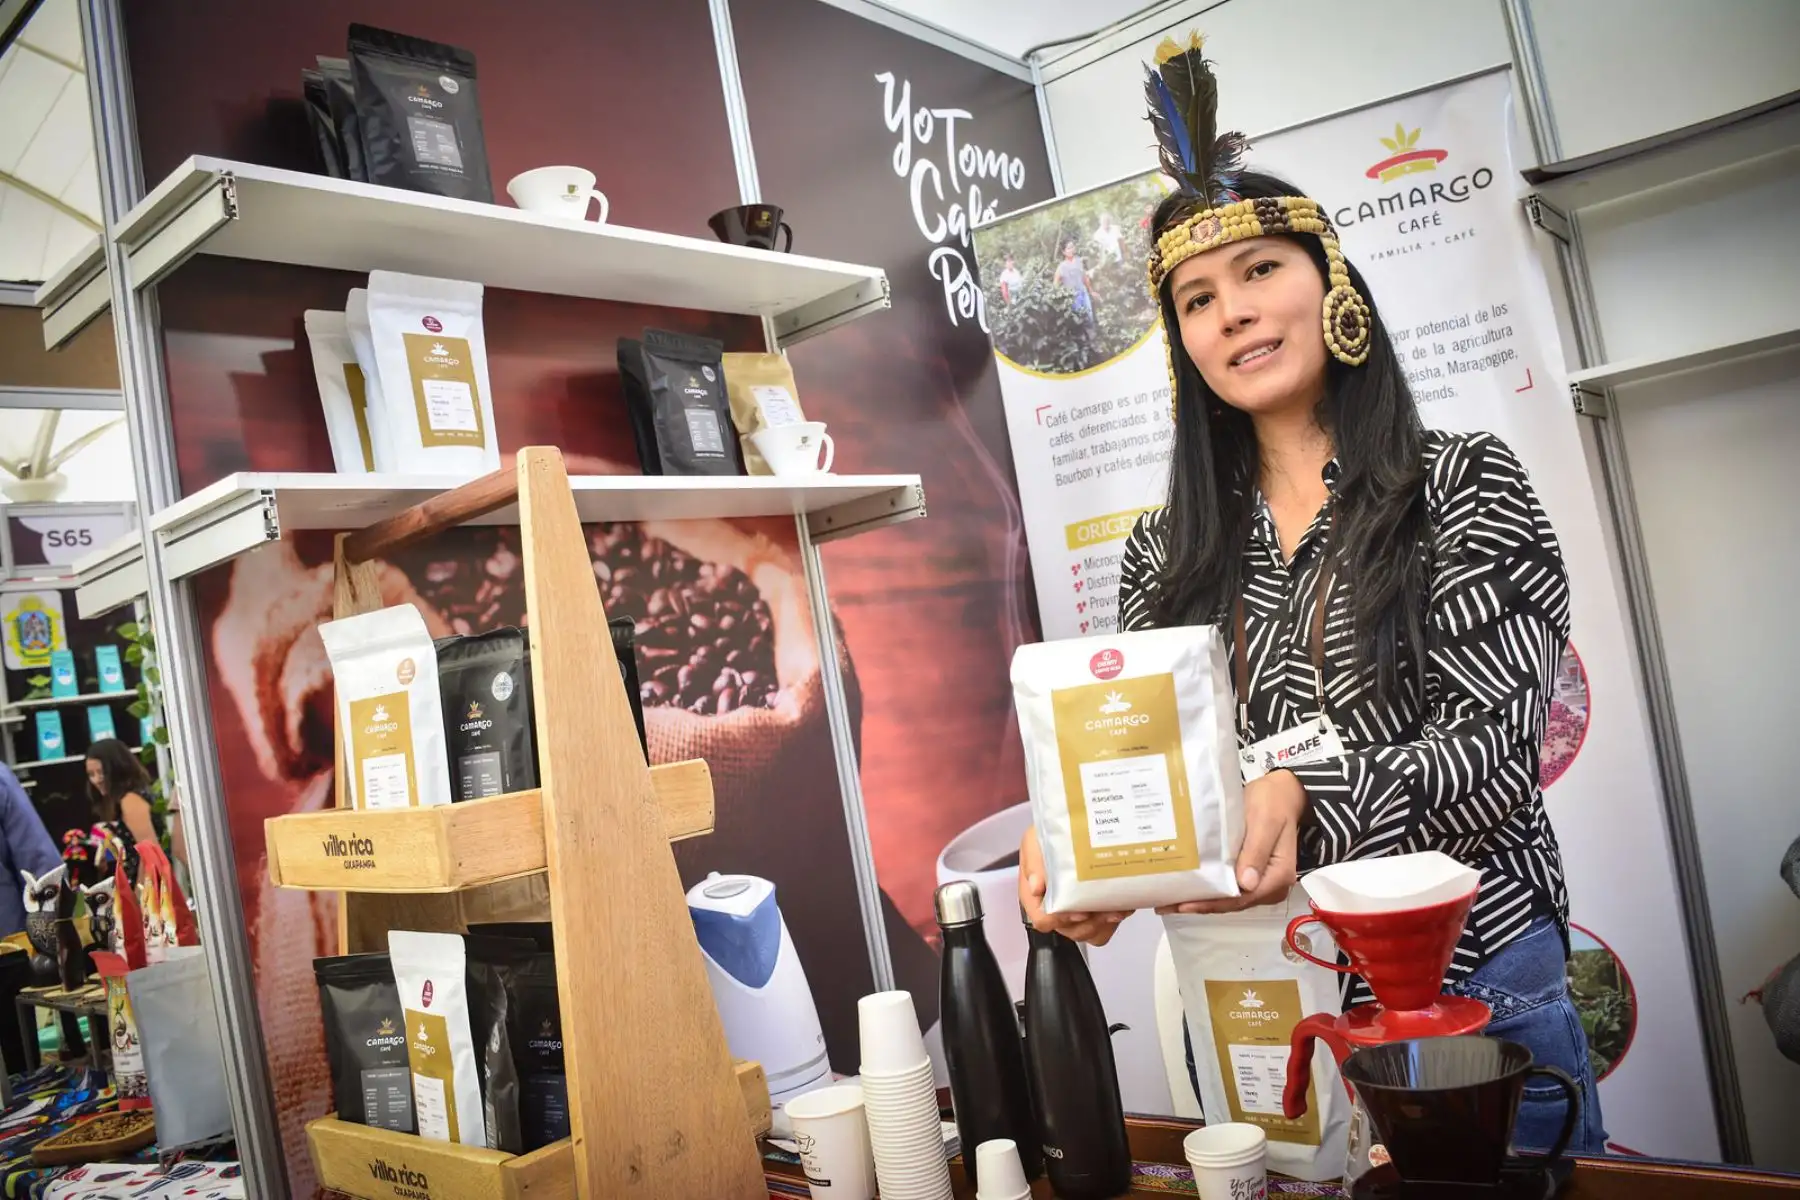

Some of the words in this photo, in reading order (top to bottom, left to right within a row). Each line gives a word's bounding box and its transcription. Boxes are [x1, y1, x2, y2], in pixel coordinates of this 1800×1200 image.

[875, 71, 934, 177] Yo
[931, 108, 1025, 194] Tomo
[1334, 167, 1493, 227] CAMARGO
[1398, 210, 1442, 234] CAFÉ
[1370, 242, 1422, 260] FAMILIA
[928, 246, 991, 333] Per
[1416, 314, 1470, 339] potencial
[1474, 310, 1488, 323] de
[1492, 303, 1508, 318] los
[1412, 347, 1427, 360] de
[1433, 342, 1445, 355] la
[1452, 325, 1513, 353] agricultura
[1406, 366, 1445, 383] eisha,
[1447, 348, 1518, 376] Maragogipe,
[1046, 412, 1068, 428] Café
[1071, 402, 1113, 422] Camargo
[1117, 396, 1130, 408] es
[1134, 392, 1148, 404] un
[1049, 431, 1074, 448] cafés
[1079, 413, 1146, 439] diferenciados
[1153, 410, 1160, 420] a
[1090, 433, 1149, 455] trabajamos
[1152, 429, 1171, 441] con
[1055, 467, 1094, 487] Bourbon
[1096, 464, 1103, 479] y
[1104, 457, 1133, 474] cafés
[47, 529, 92, 547] S65
[1090, 594, 1120, 609] Provin
[1092, 613, 1118, 629] Depa
[460, 719, 493, 732] CAMARGO
[1085, 714, 1150, 731] CAMARGO
[322, 834, 348, 856] villa
[349, 832, 375, 856] rica
[1229, 1010, 1280, 1021] CAMARGO
[366, 1036, 405, 1047] CAMARGO
[368, 1158, 398, 1183] villa
[398, 1163, 428, 1189] rica
